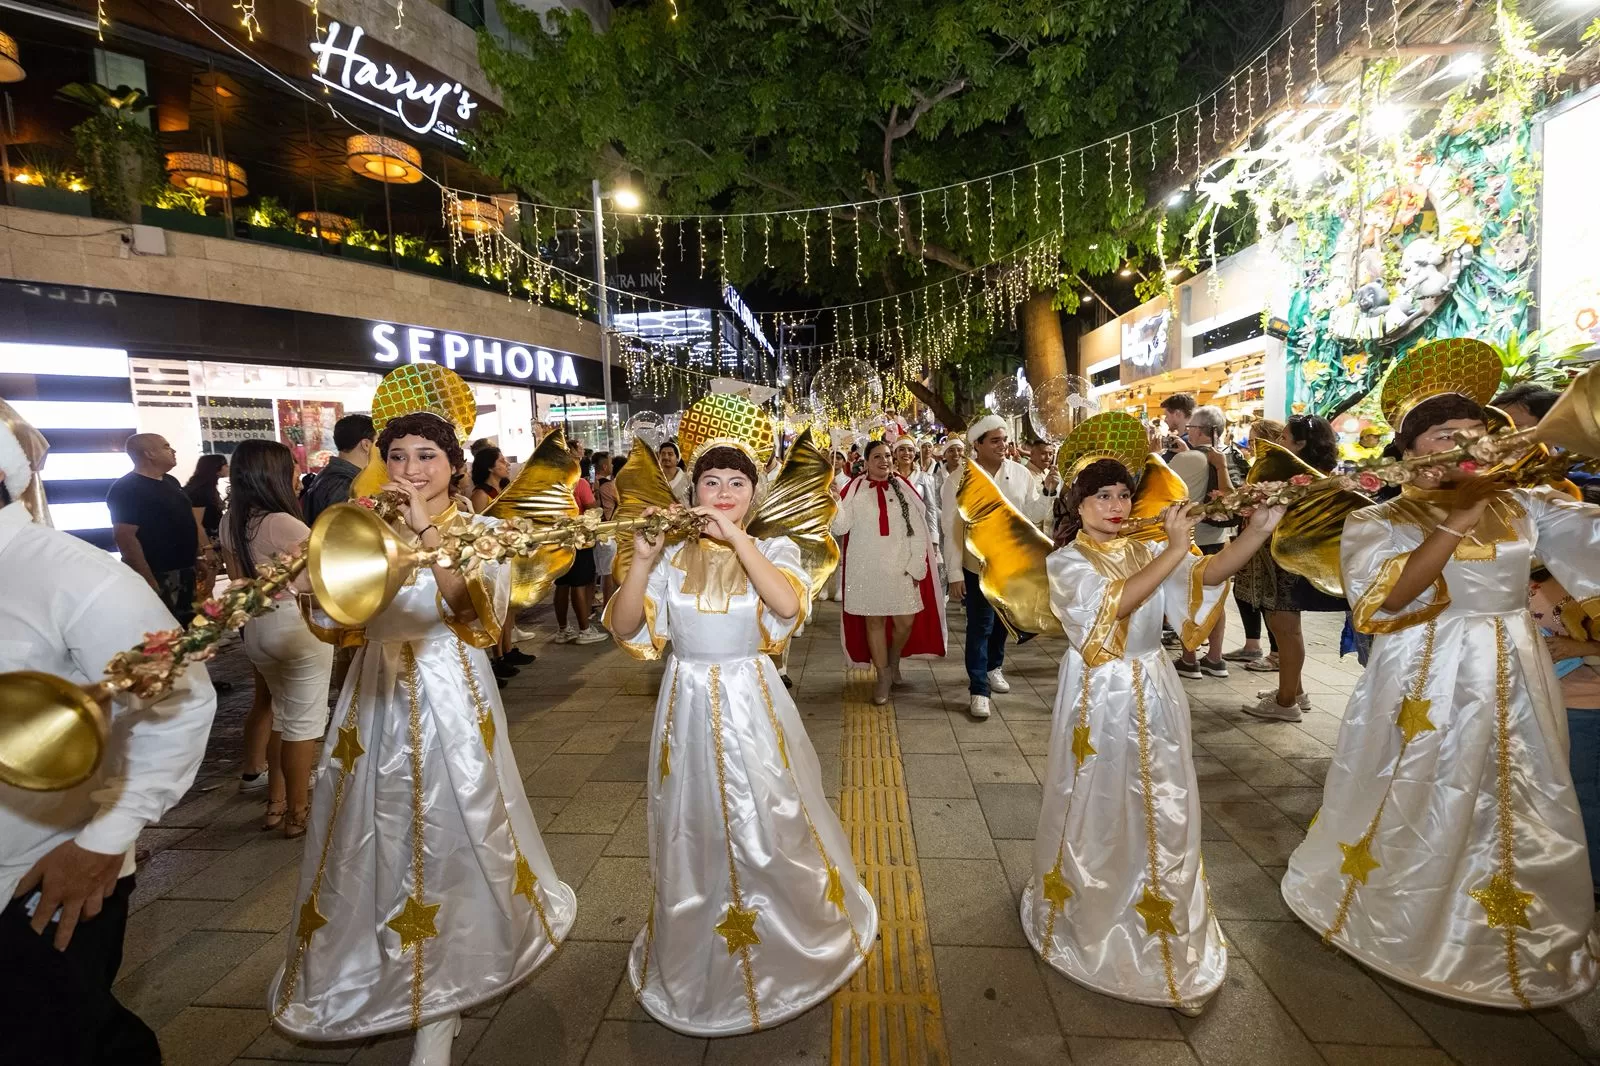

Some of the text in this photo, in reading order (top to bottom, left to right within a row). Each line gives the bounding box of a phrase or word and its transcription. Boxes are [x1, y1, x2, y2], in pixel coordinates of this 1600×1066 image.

[310, 21, 478, 134] Harry's
[436, 120, 458, 135] GR
[640, 272, 662, 288] INK
[372, 323, 579, 387] SEPHORA
[211, 431, 267, 439] SEPHORA
